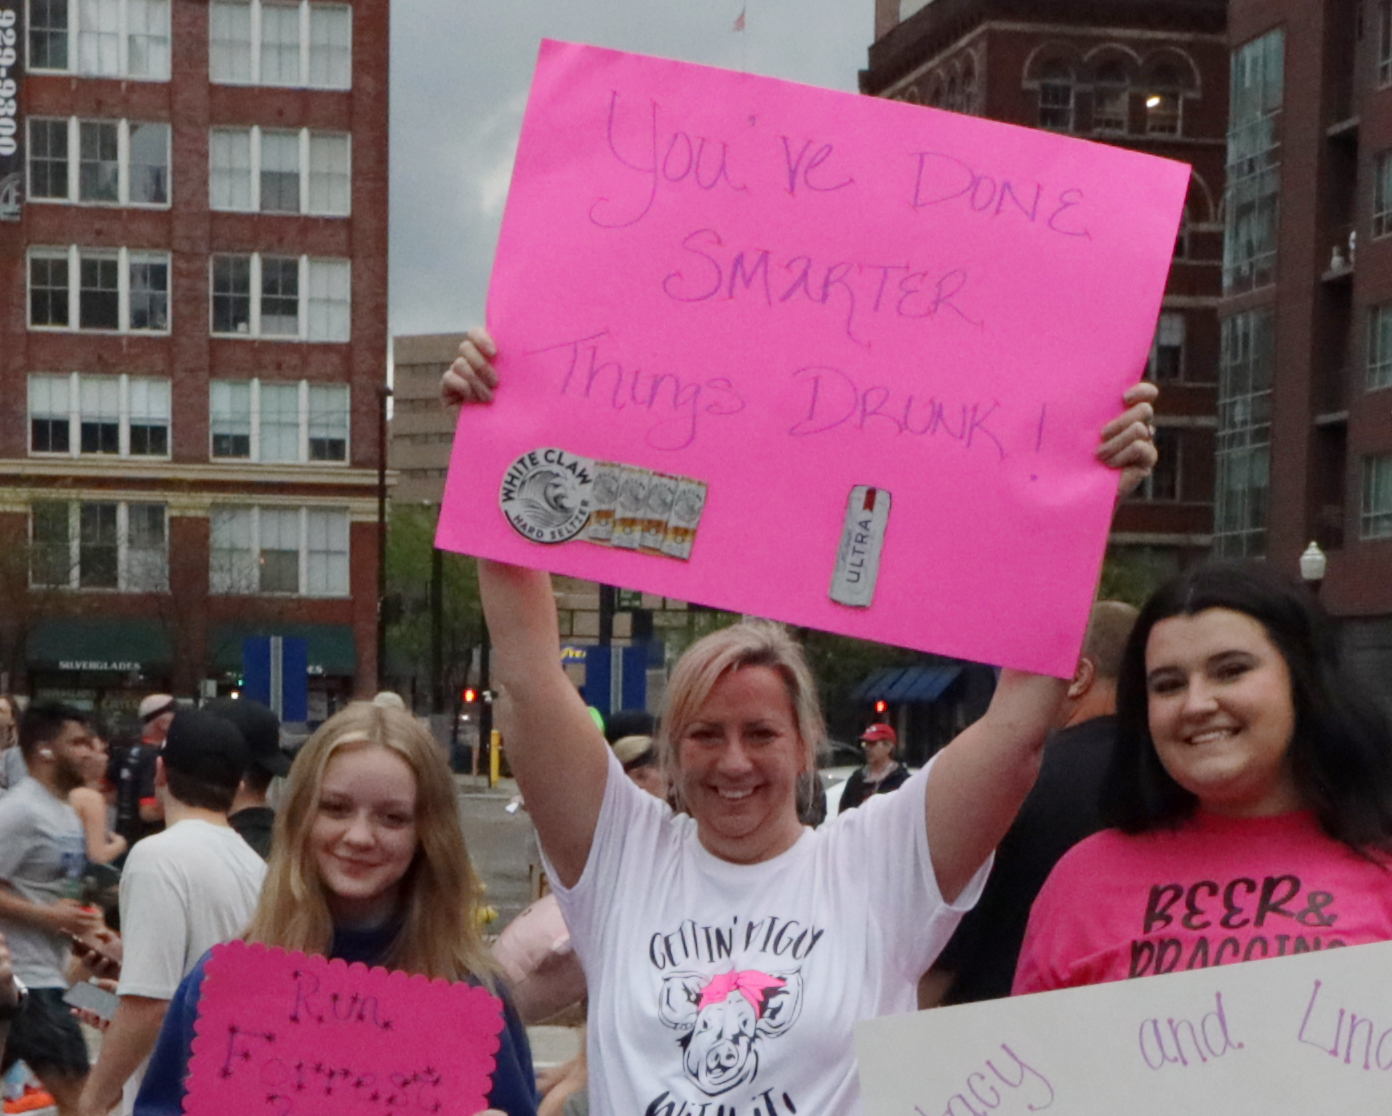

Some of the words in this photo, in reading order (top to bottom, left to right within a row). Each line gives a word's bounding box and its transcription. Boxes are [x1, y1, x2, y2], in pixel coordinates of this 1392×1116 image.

[523, 331, 746, 450] Things
[501, 451, 539, 503] WHITE
[544, 449, 593, 486] CLAW
[513, 514, 544, 539] HARD
[550, 499, 590, 540] SELTZER
[846, 519, 872, 584] ULTRA
[59, 660, 141, 671] SILVERGLADES
[290, 970, 393, 1030] Run
[1138, 991, 1243, 1070] and
